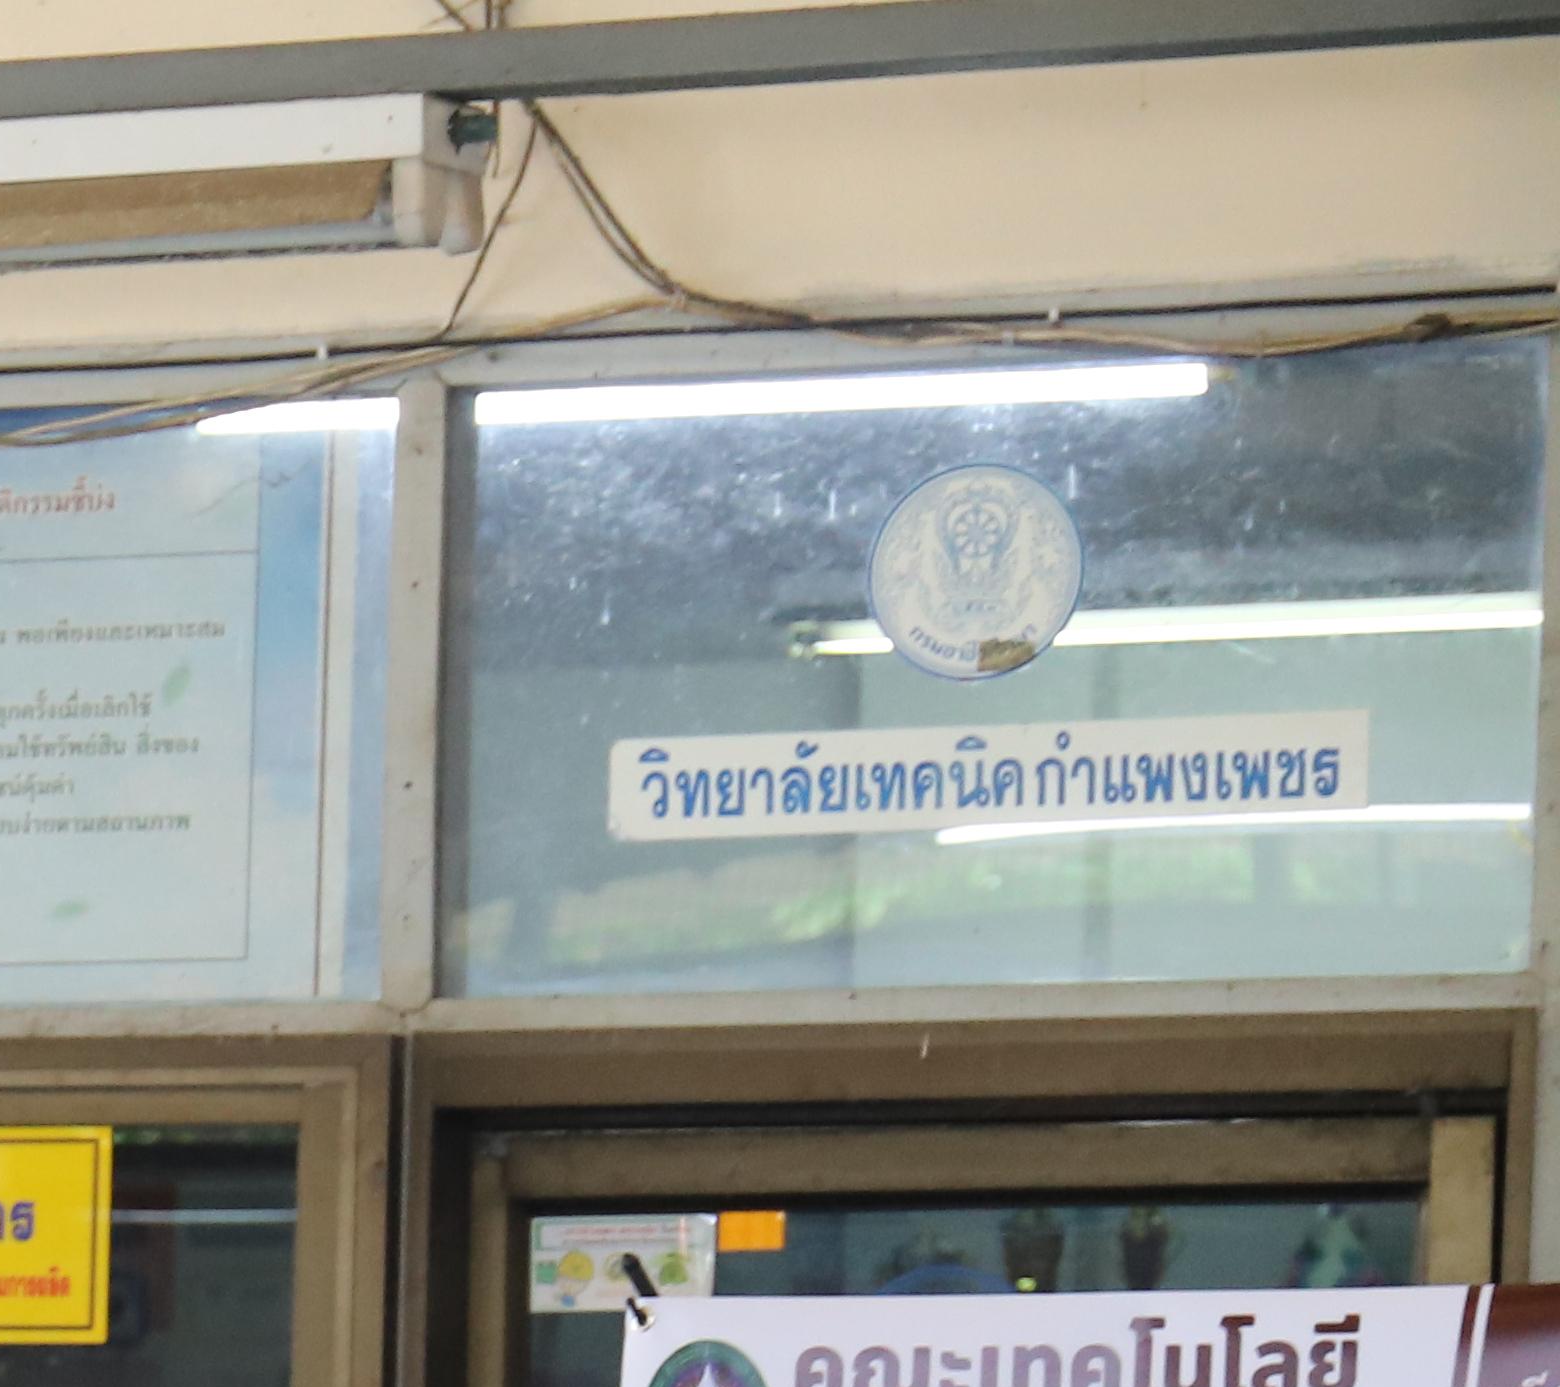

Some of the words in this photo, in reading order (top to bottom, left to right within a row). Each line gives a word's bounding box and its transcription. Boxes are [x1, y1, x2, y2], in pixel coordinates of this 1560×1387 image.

[639, 733, 1340, 822] วิทยาลัยเทคนิคกำแพงเพชร
